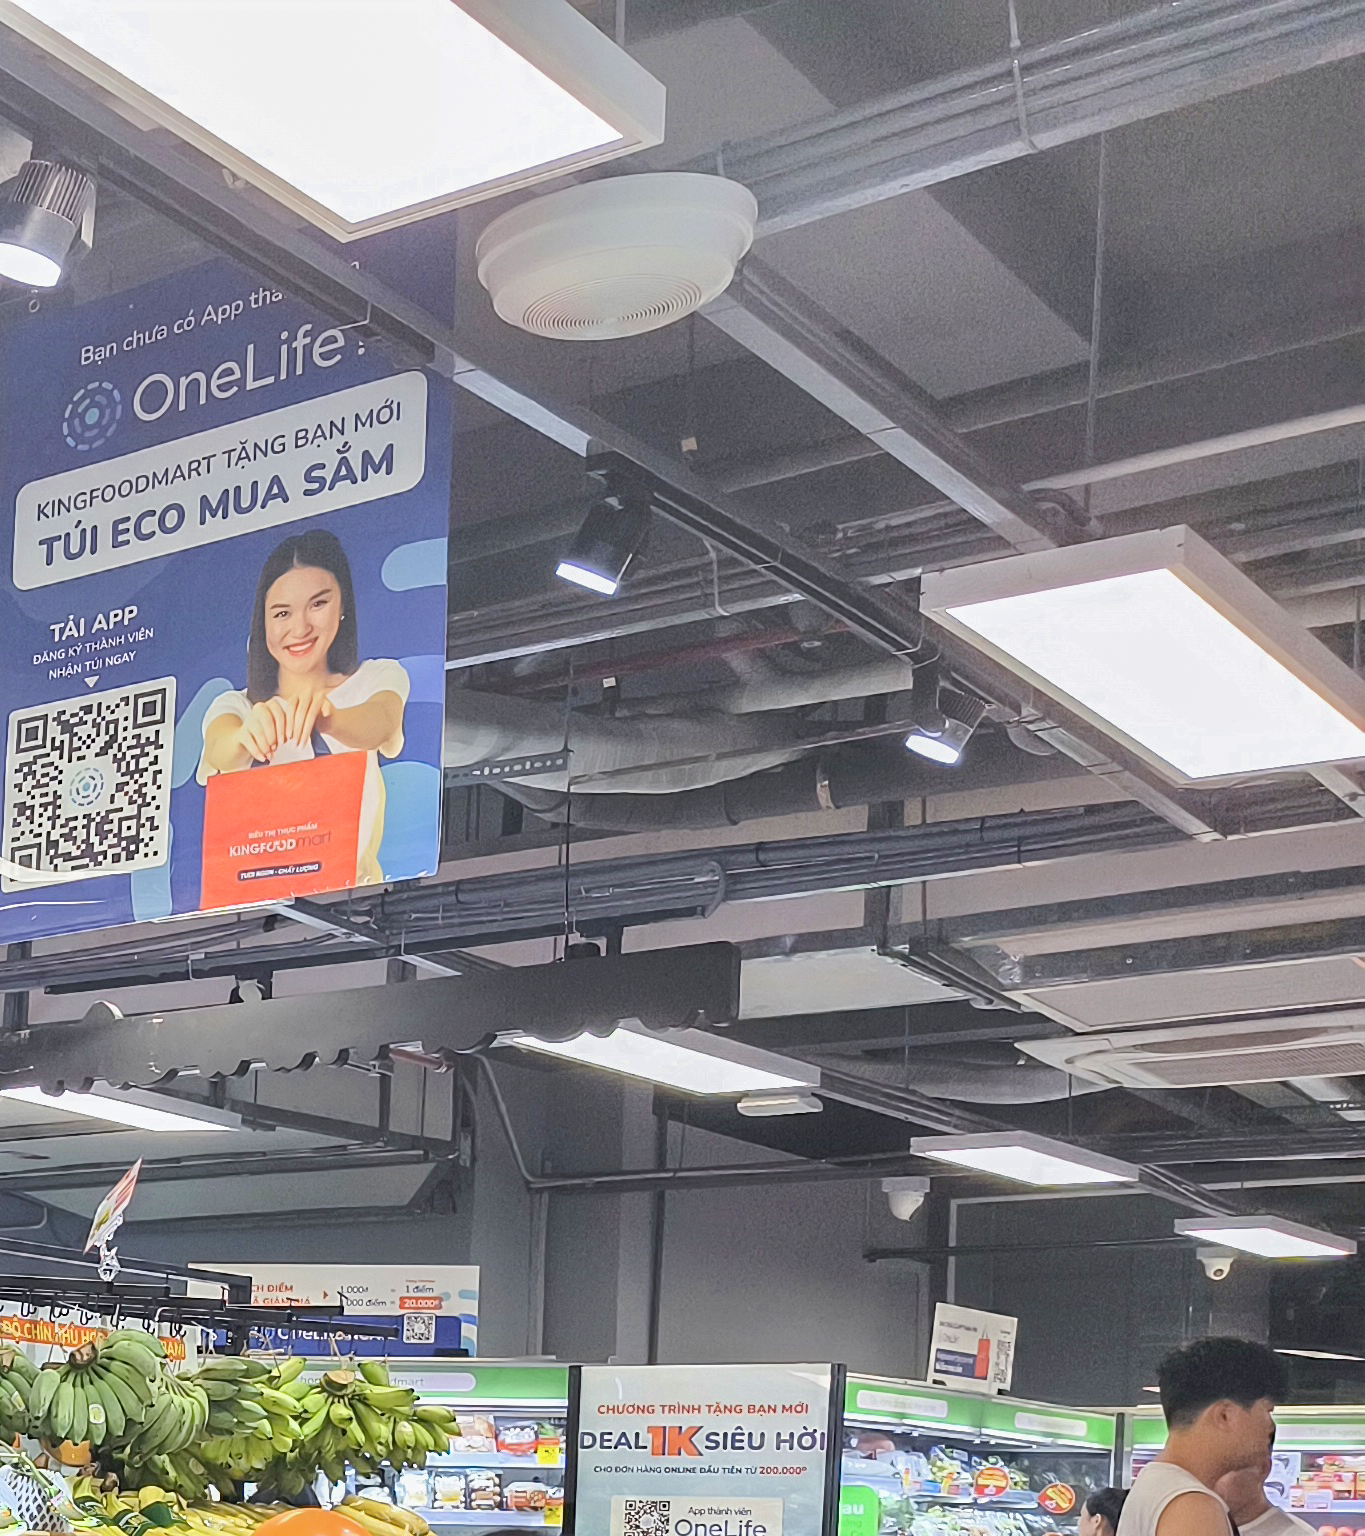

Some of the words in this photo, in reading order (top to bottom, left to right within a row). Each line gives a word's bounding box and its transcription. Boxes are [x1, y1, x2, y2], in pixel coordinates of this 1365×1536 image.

[80, 339, 117, 366] Bạn
[122, 319, 167, 351] chưa
[172, 311, 195, 335] có
[201, 300, 244, 330] App
[36, 453, 217, 521] KINGFOODMART
[221, 434, 287, 471] TẶNG
[294, 417, 345, 452] BẠN
[354, 400, 402, 429] MỚI
[39, 523, 99, 567] TÚI
[112, 502, 187, 549] ECO
[199, 475, 290, 527] MUA
[302, 443, 394, 497] SẮM
[50, 615, 84, 642] TẢI
[91, 605, 137, 633] APP
[33, 649, 65, 664] ĐĂNG
[85, 635, 124, 653] THÀNH
[128, 627, 154, 642] VIÊN
[49, 663, 81, 680] NHẬN
[85, 657, 102, 672] TÚI
[105, 651, 136, 667] NGAY
[597, 1403, 655, 1415] CHƯƠNG
[659, 1401, 701, 1414] TRÌNH
[705, 1402, 743, 1417] TẶNG
[747, 1403, 777, 1417] BẠN
[781, 1402, 809, 1414] MỚI
[579, 1431, 647, 1450] DEAL
[647, 1425, 704, 1457] 1K
[704, 1425, 765, 1451] SIÊU
[775, 1426, 826, 1451] HỜI
[664, 1466, 697, 1474] ONLINE
[688, 1506, 705, 1516] App
[707, 1506, 731, 1515] thành
